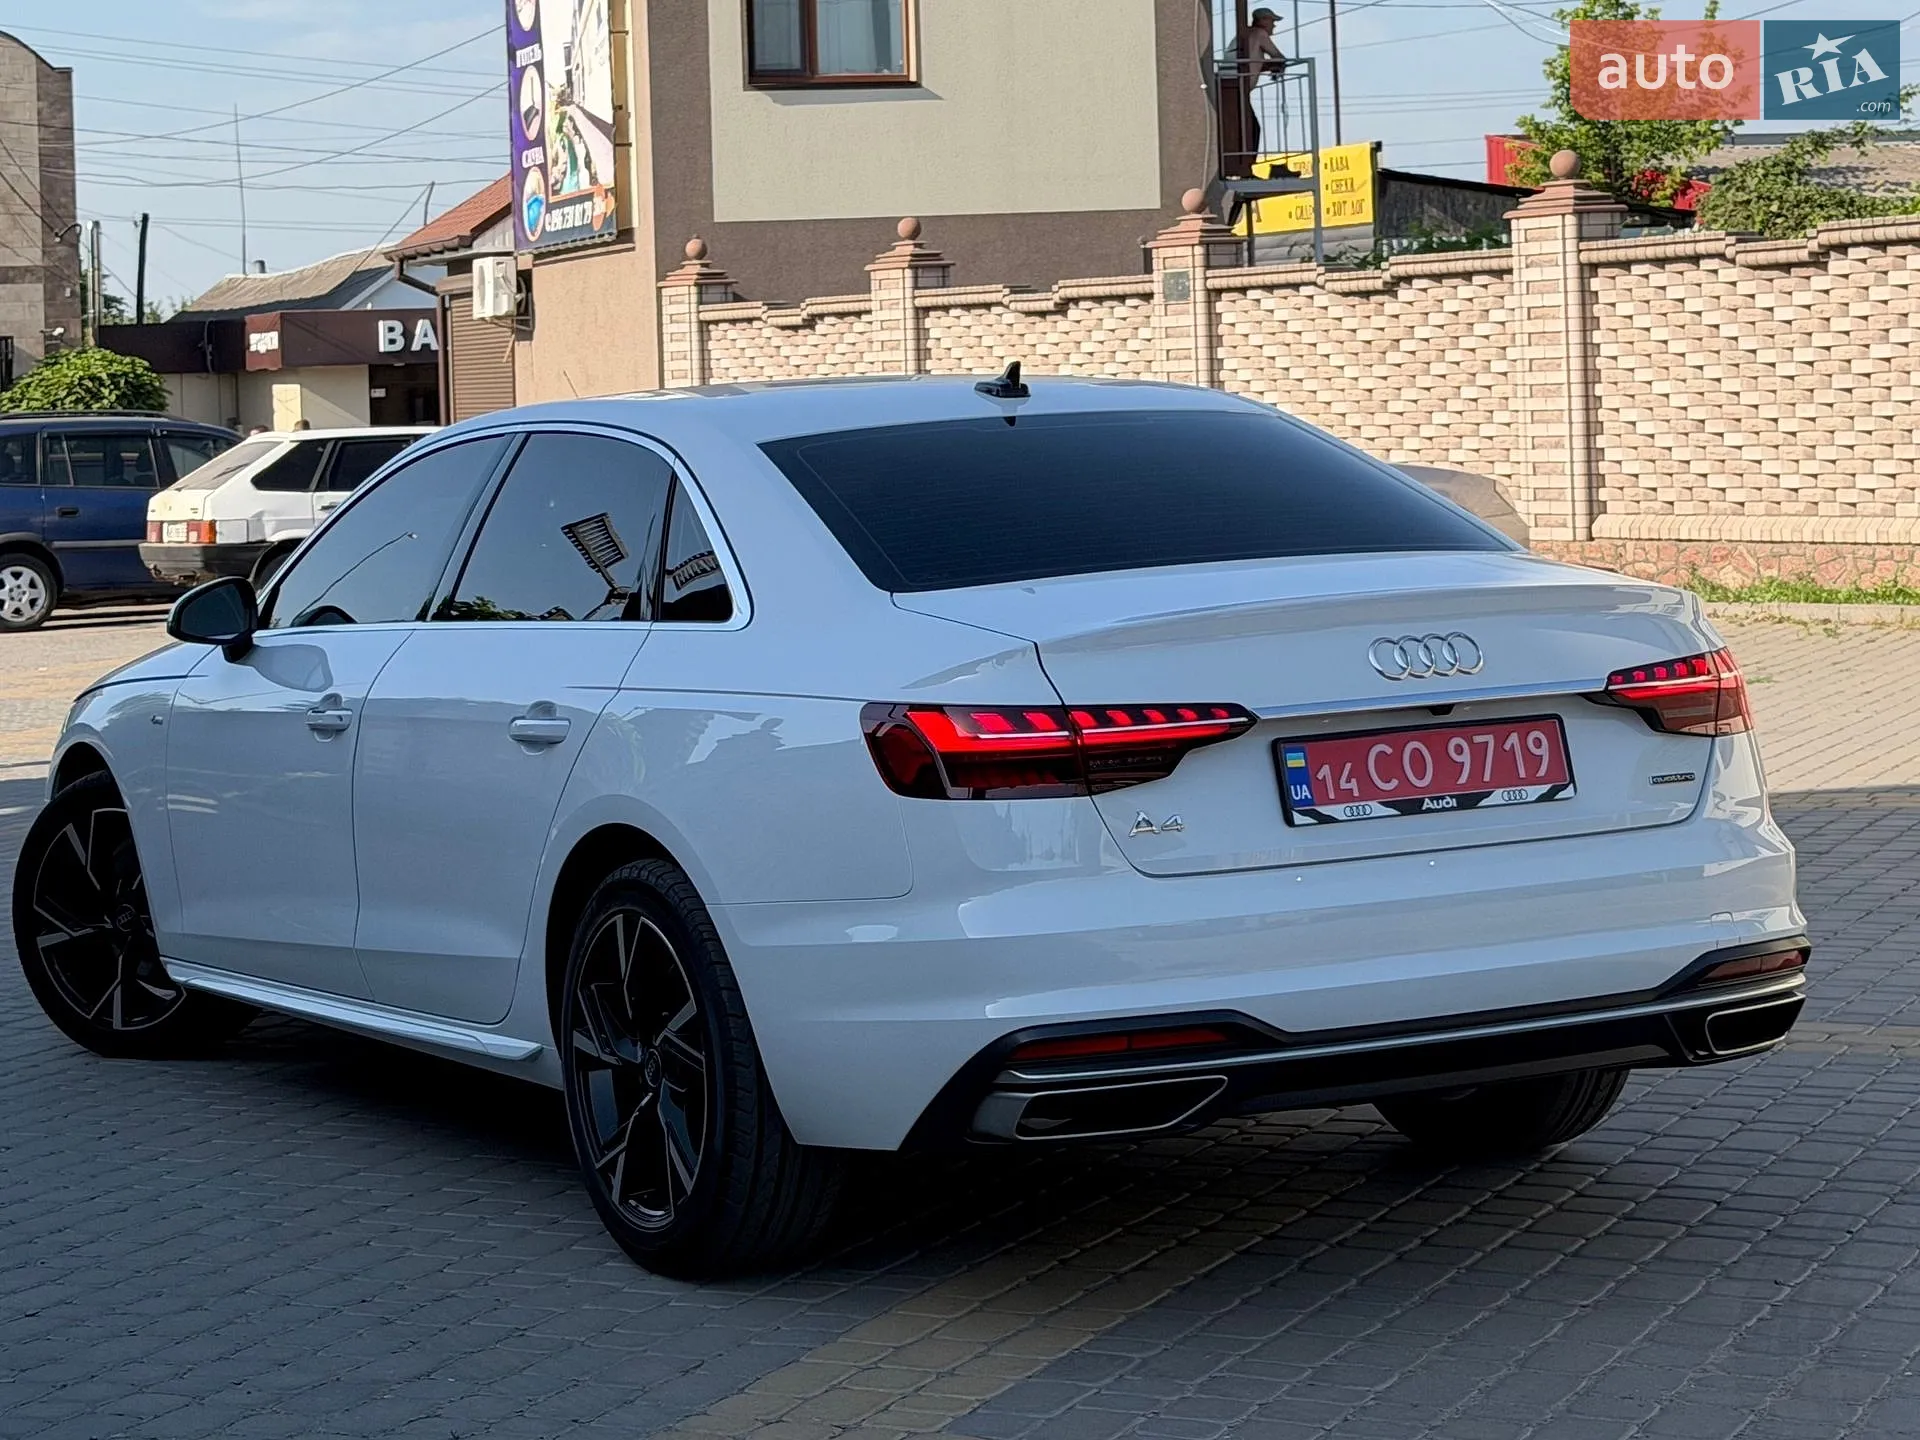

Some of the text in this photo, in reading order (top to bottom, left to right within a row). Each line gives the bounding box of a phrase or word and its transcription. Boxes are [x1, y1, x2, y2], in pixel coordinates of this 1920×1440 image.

[1331, 199, 1348, 217] ХОТ
[1315, 729, 1550, 800] 14 CO 9719
[1652, 772, 1696, 784] quattro
[1290, 784, 1312, 800] UA
[1421, 796, 1458, 811] Audi
[1128, 808, 1185, 838] A4
